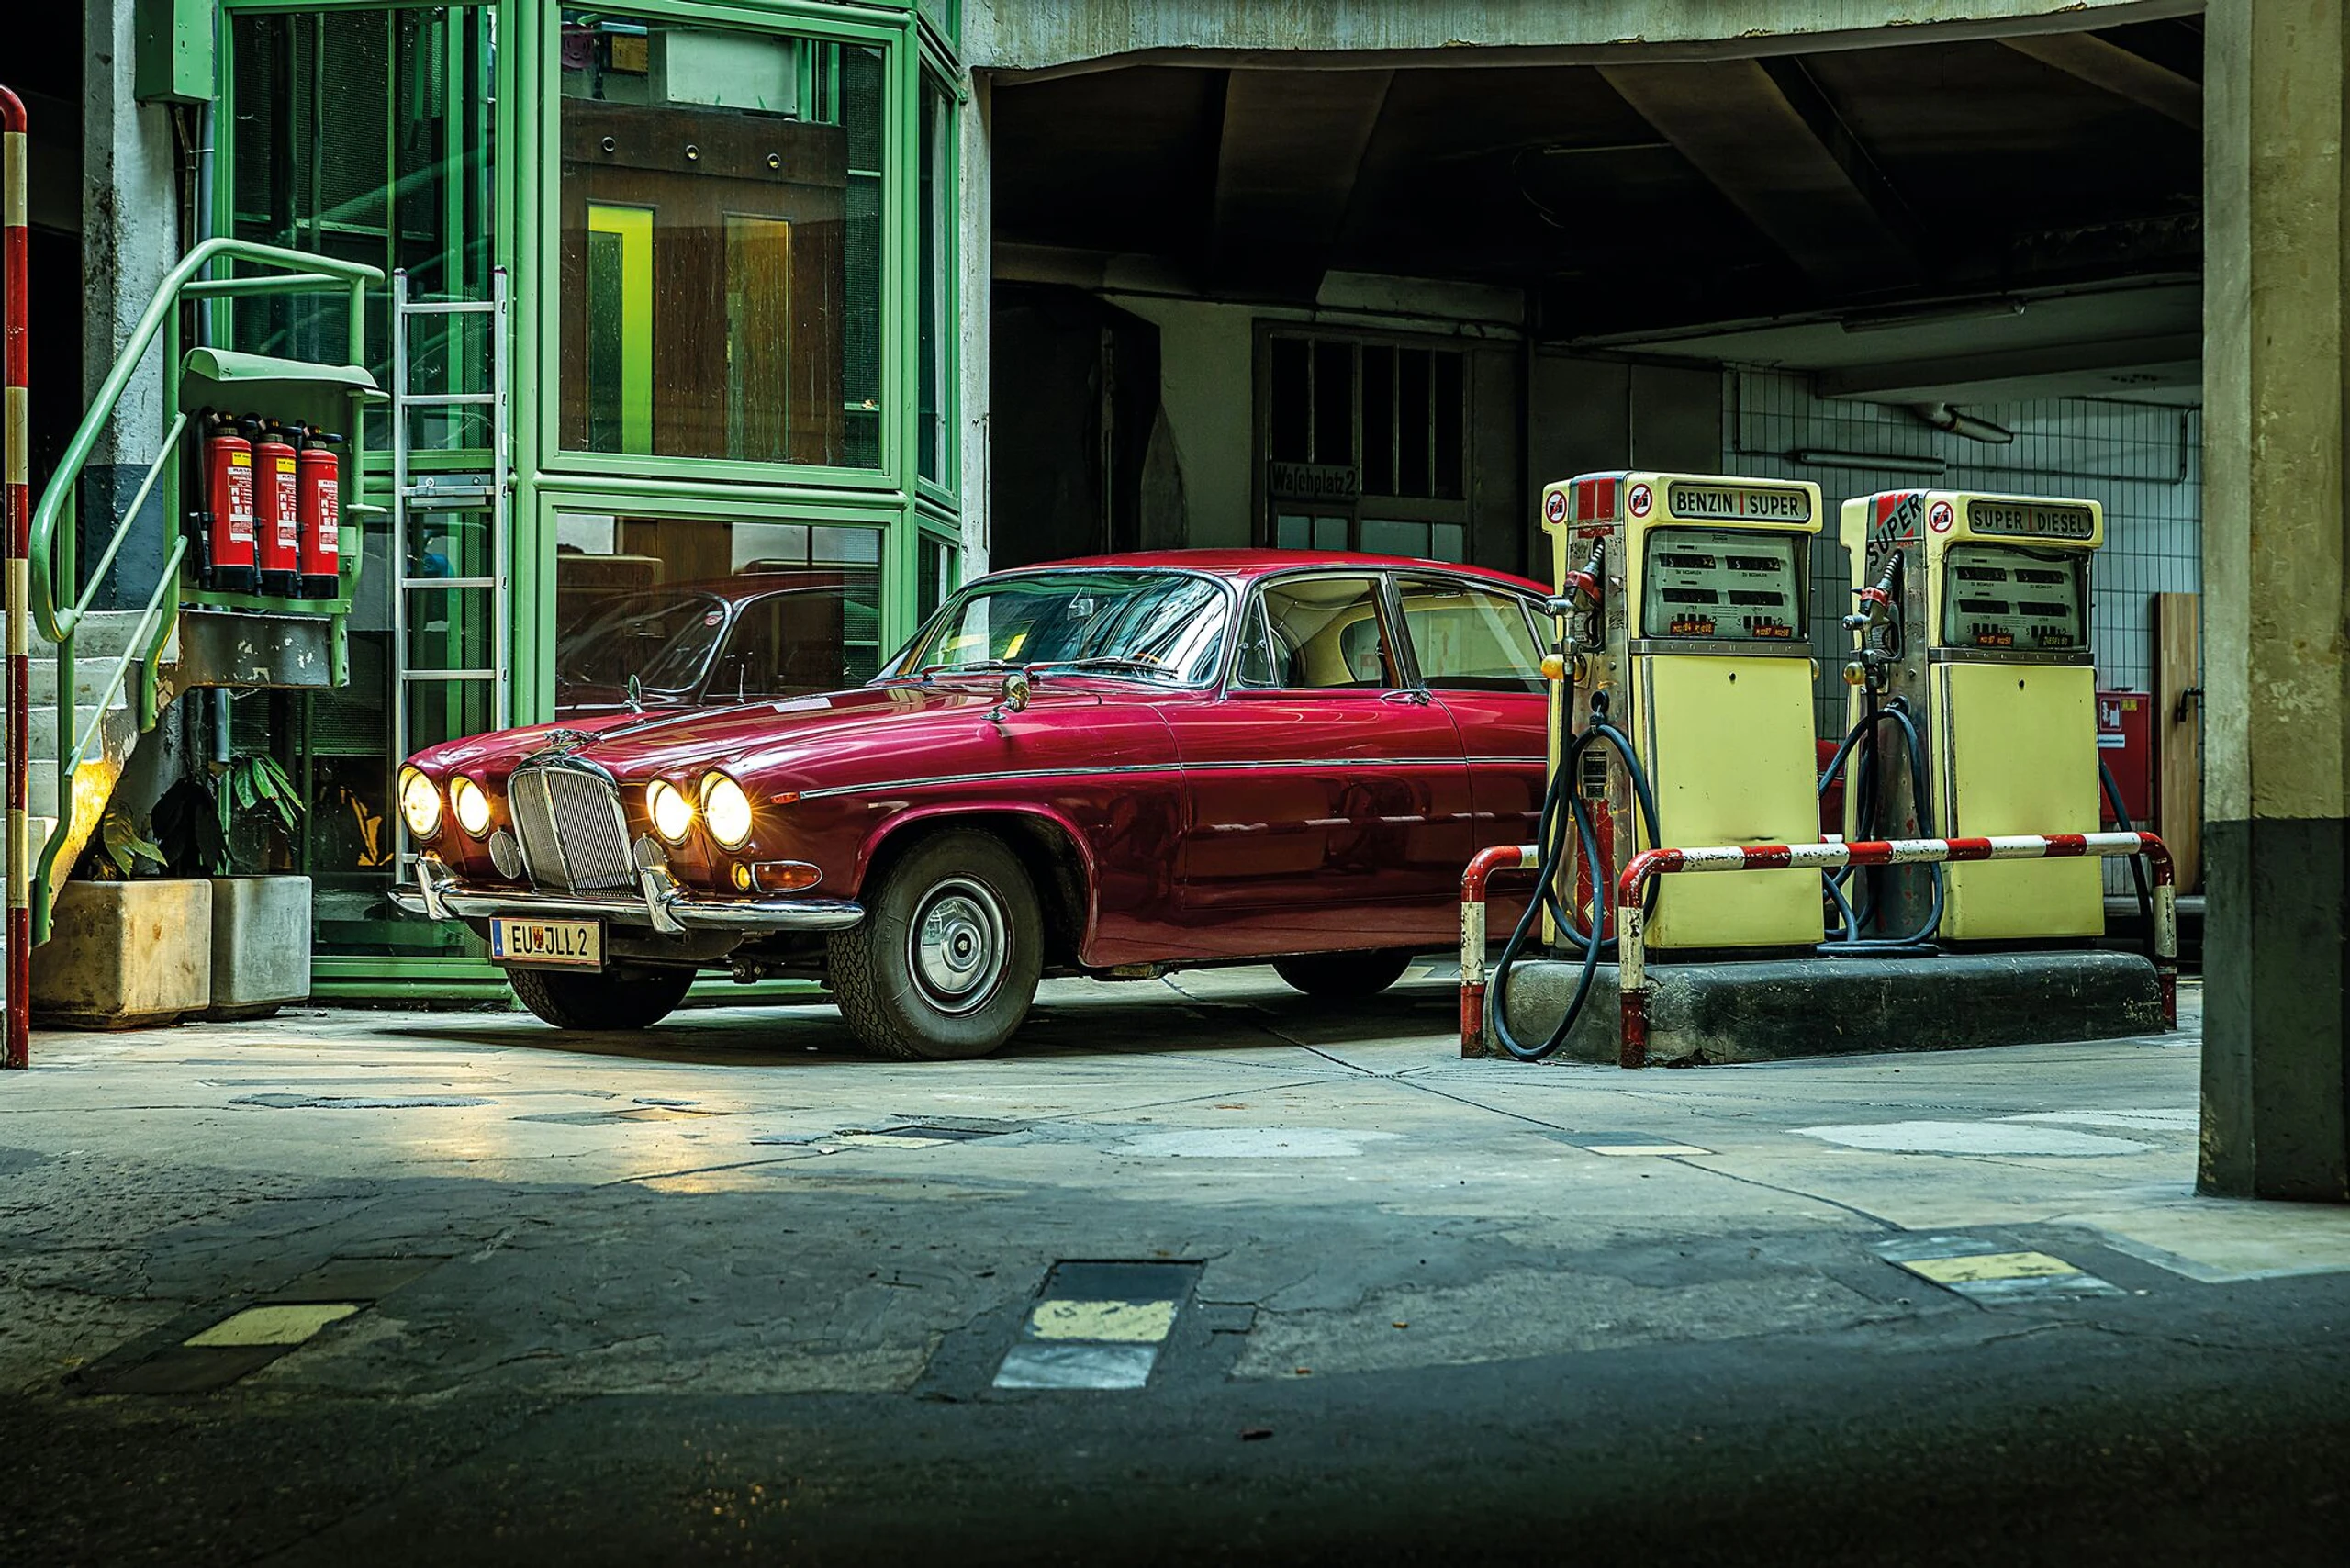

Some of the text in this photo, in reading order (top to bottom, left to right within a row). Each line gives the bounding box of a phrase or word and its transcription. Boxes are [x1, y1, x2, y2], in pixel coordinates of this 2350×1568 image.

[1346, 470, 1355, 494] 2
[1677, 491, 1799, 515] BENZIN SUPER
[1866, 493, 1922, 566] SUPER
[1974, 510, 2085, 532] SUPER DIESEL
[496, 943, 502, 951] A
[512, 926, 588, 956] EU JLL 2
